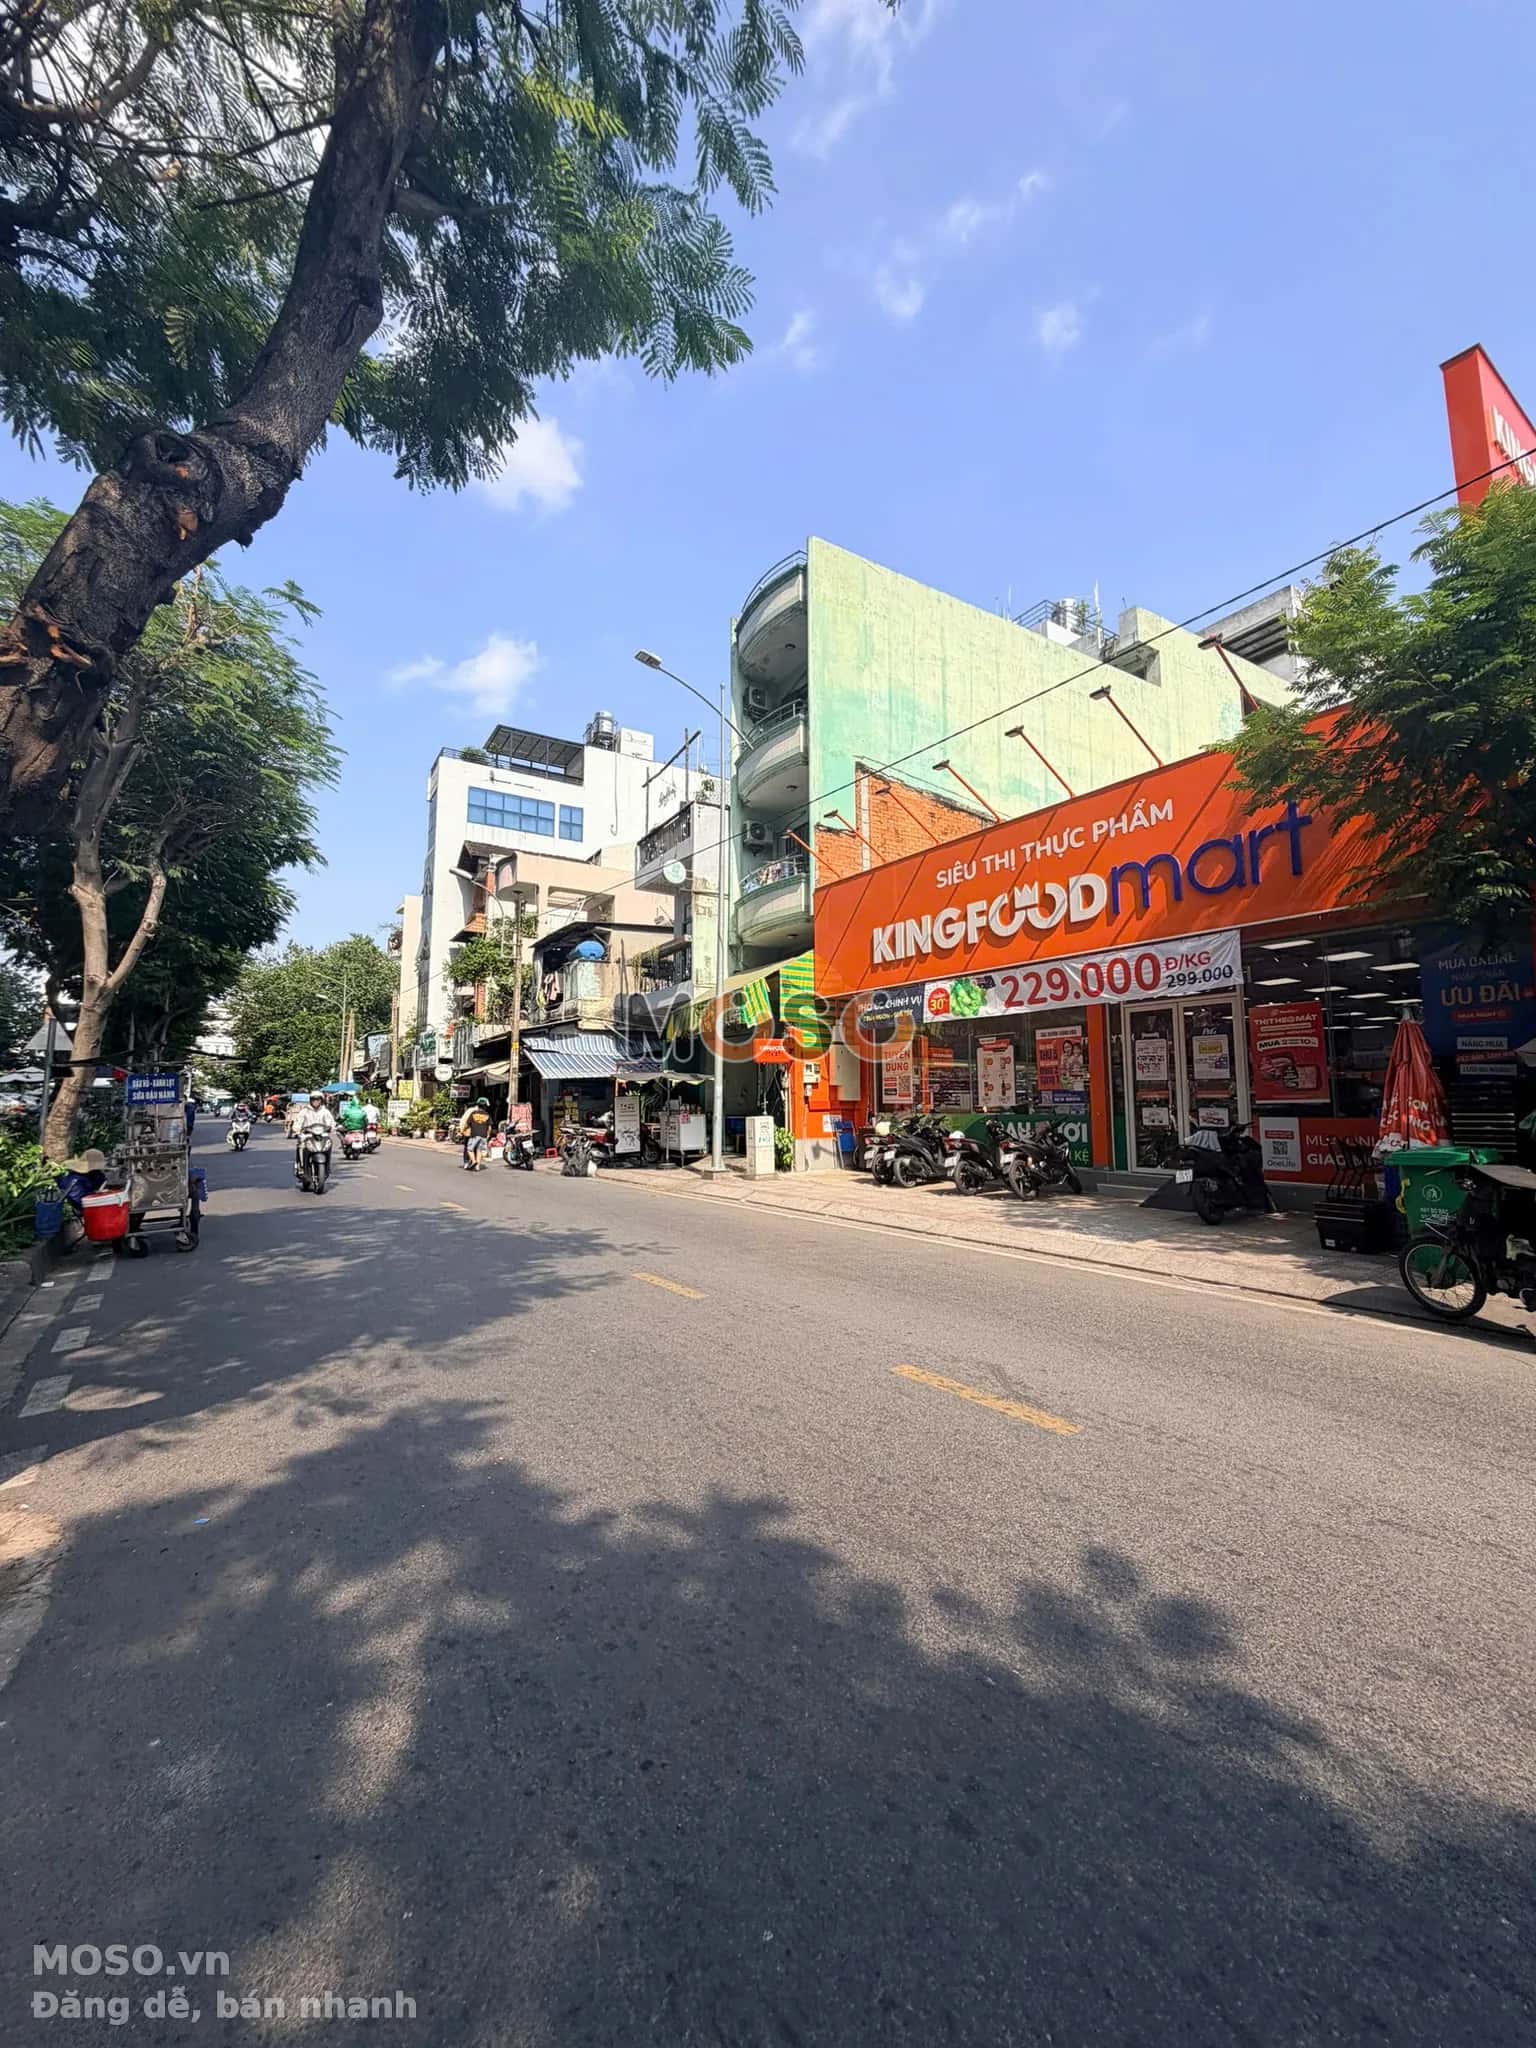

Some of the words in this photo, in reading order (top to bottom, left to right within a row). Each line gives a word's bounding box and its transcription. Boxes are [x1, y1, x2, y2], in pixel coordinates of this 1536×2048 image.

[935, 860, 977, 888] SIÊU
[981, 849, 1016, 872] THỊ
[1020, 826, 1086, 862] THỰC
[1092, 797, 1174, 843] PHẨM
[1000, 952, 1162, 1009] 229.000
[1164, 950, 1212, 972] Đ/KG
[1165, 964, 1234, 988] 299.000
[1440, 985, 1473, 1007] ƯU
[1479, 978, 1520, 1003] ĐÃI
[1258, 1039, 1281, 1050] MUA
